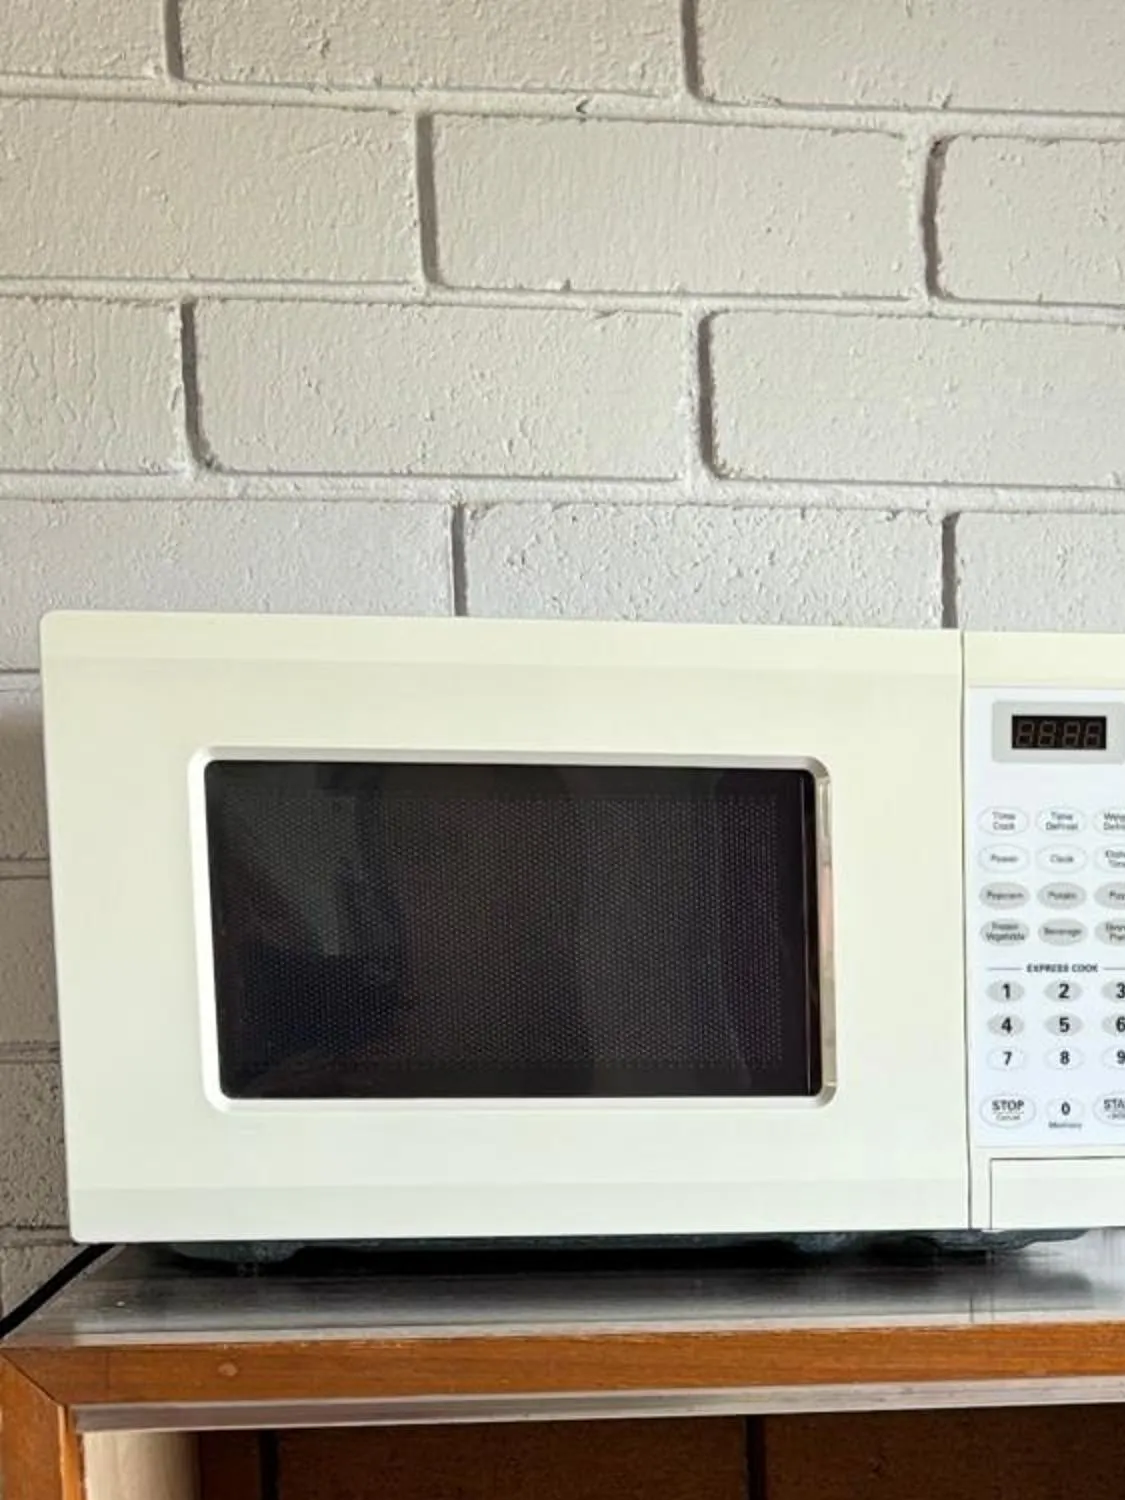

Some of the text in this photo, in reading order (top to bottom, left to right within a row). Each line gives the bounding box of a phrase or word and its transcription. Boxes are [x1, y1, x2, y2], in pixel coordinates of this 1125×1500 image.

[1026, 963, 1099, 973] EXPRESS COOK
[1002, 982, 1011, 999] 1
[1058, 982, 1070, 999] 2
[1001, 1016, 1013, 1033] 4
[1059, 1016, 1070, 1033] 5
[1002, 1051, 1013, 1066] 7
[1059, 1050, 1070, 1065] 8
[991, 1099, 1025, 1111] STOP
[1060, 1101, 1071, 1116] 0
